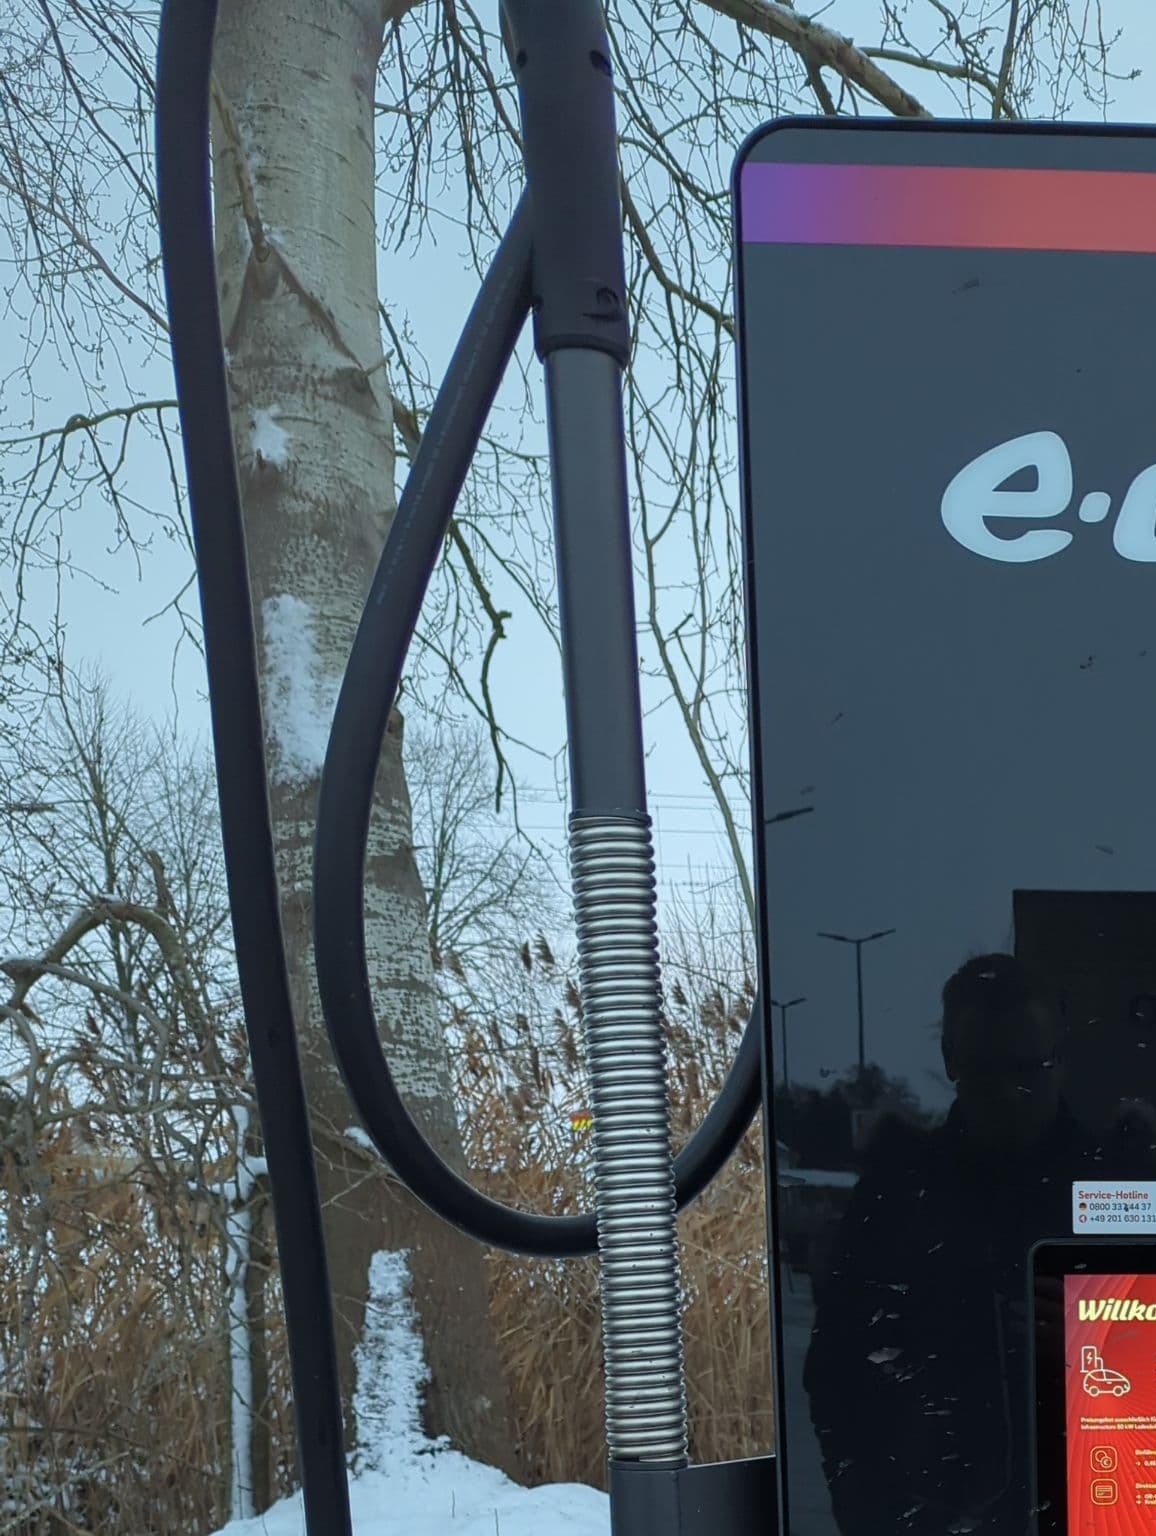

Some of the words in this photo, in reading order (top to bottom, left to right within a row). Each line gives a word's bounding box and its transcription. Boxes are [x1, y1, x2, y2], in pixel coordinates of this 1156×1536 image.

[1078, 1190, 1149, 1200] Service-Hotline
[1089, 1203, 1110, 1211] 0800
[1141, 1203, 1151, 1211] 37
[1090, 1214, 1105, 1223] +49
[1107, 1214, 1122, 1223] 201
[1124, 1214, 1140, 1223] 630
[1142, 1214, 1156, 1223] 131
